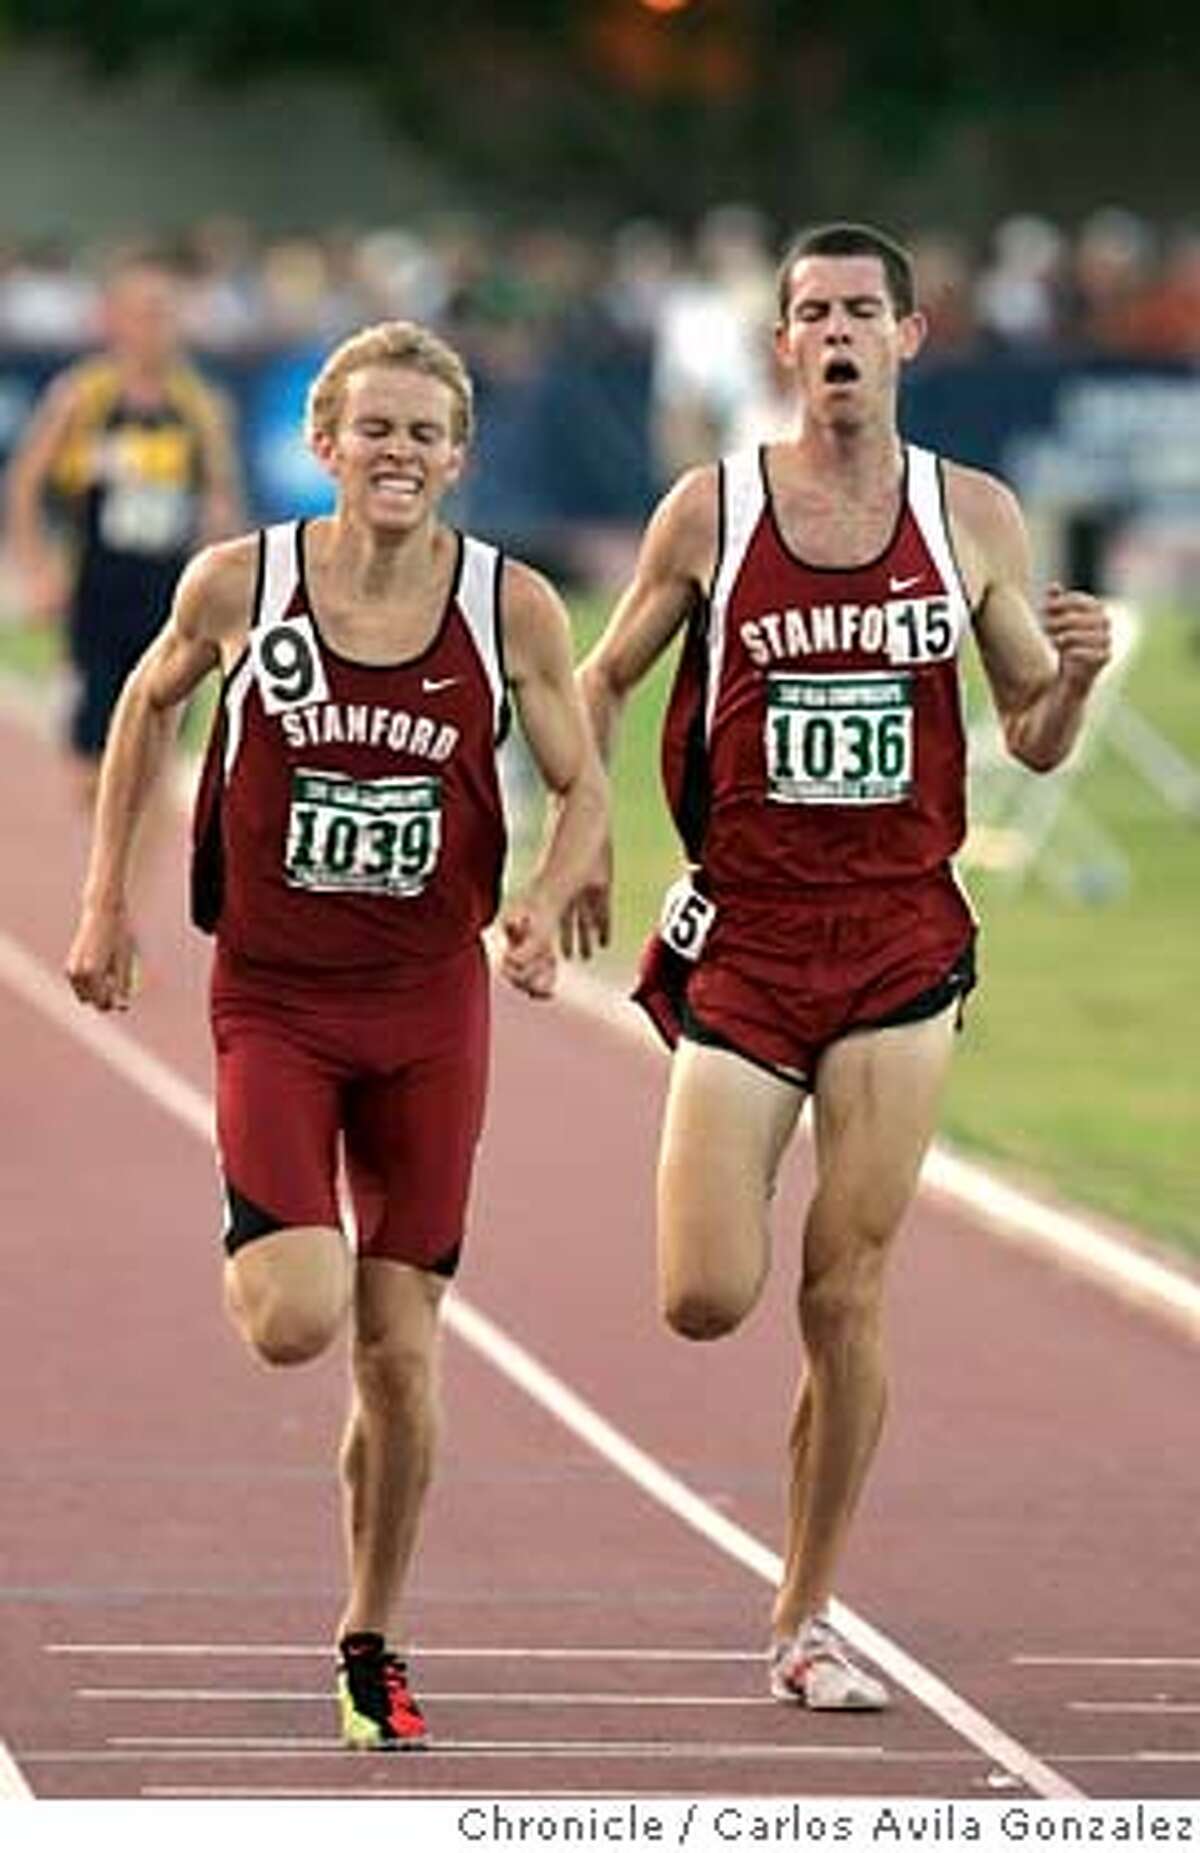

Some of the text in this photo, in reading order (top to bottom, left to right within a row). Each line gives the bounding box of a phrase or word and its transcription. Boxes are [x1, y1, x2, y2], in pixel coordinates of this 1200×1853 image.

[740, 604, 889, 664] STANFO
[896, 602, 951, 659] 15
[260, 626, 314, 702] 9
[281, 704, 459, 761] STANFORD
[772, 714, 906, 780] 1036
[291, 811, 432, 875] 1039
